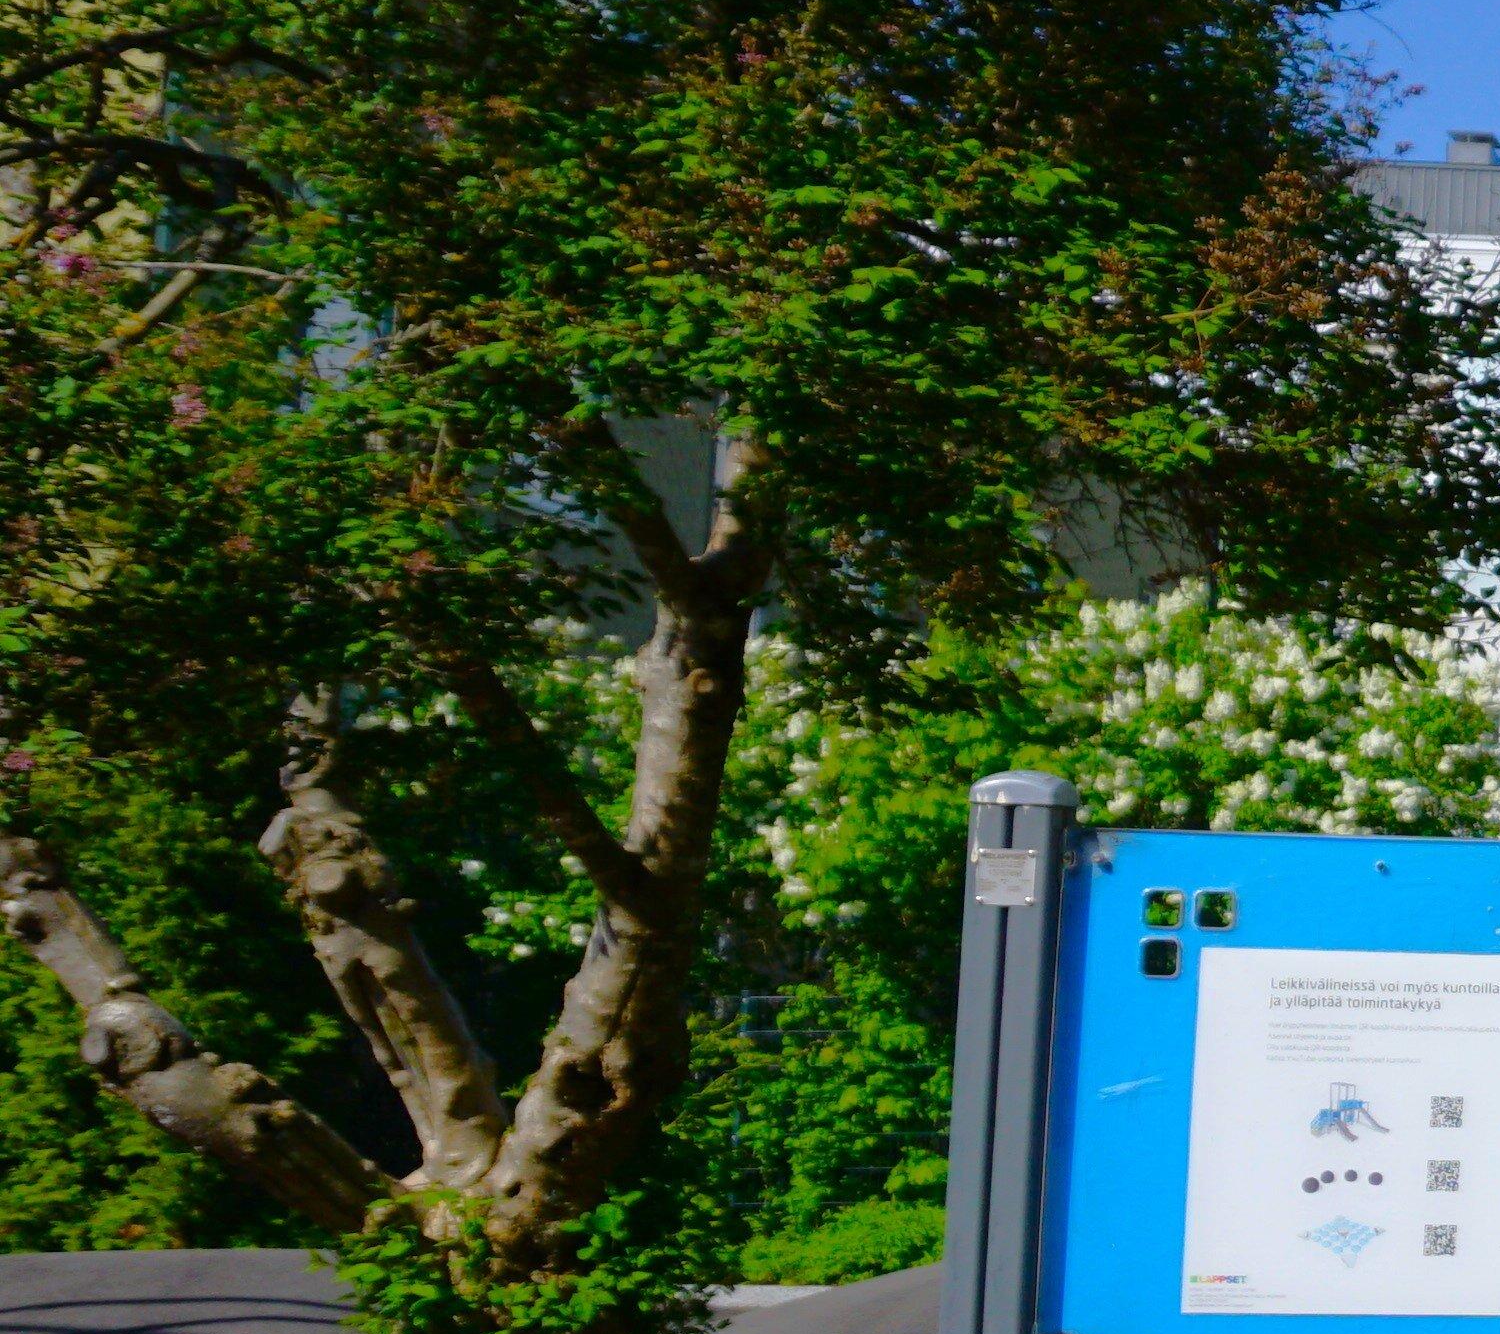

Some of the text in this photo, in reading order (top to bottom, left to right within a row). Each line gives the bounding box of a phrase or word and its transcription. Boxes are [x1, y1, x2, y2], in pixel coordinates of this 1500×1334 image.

[1270, 977, 1500, 995] Leikkivälineissä voi myös kuntoilla
[1269, 995, 1442, 1013] ja ylläpitää toimintakykyä
